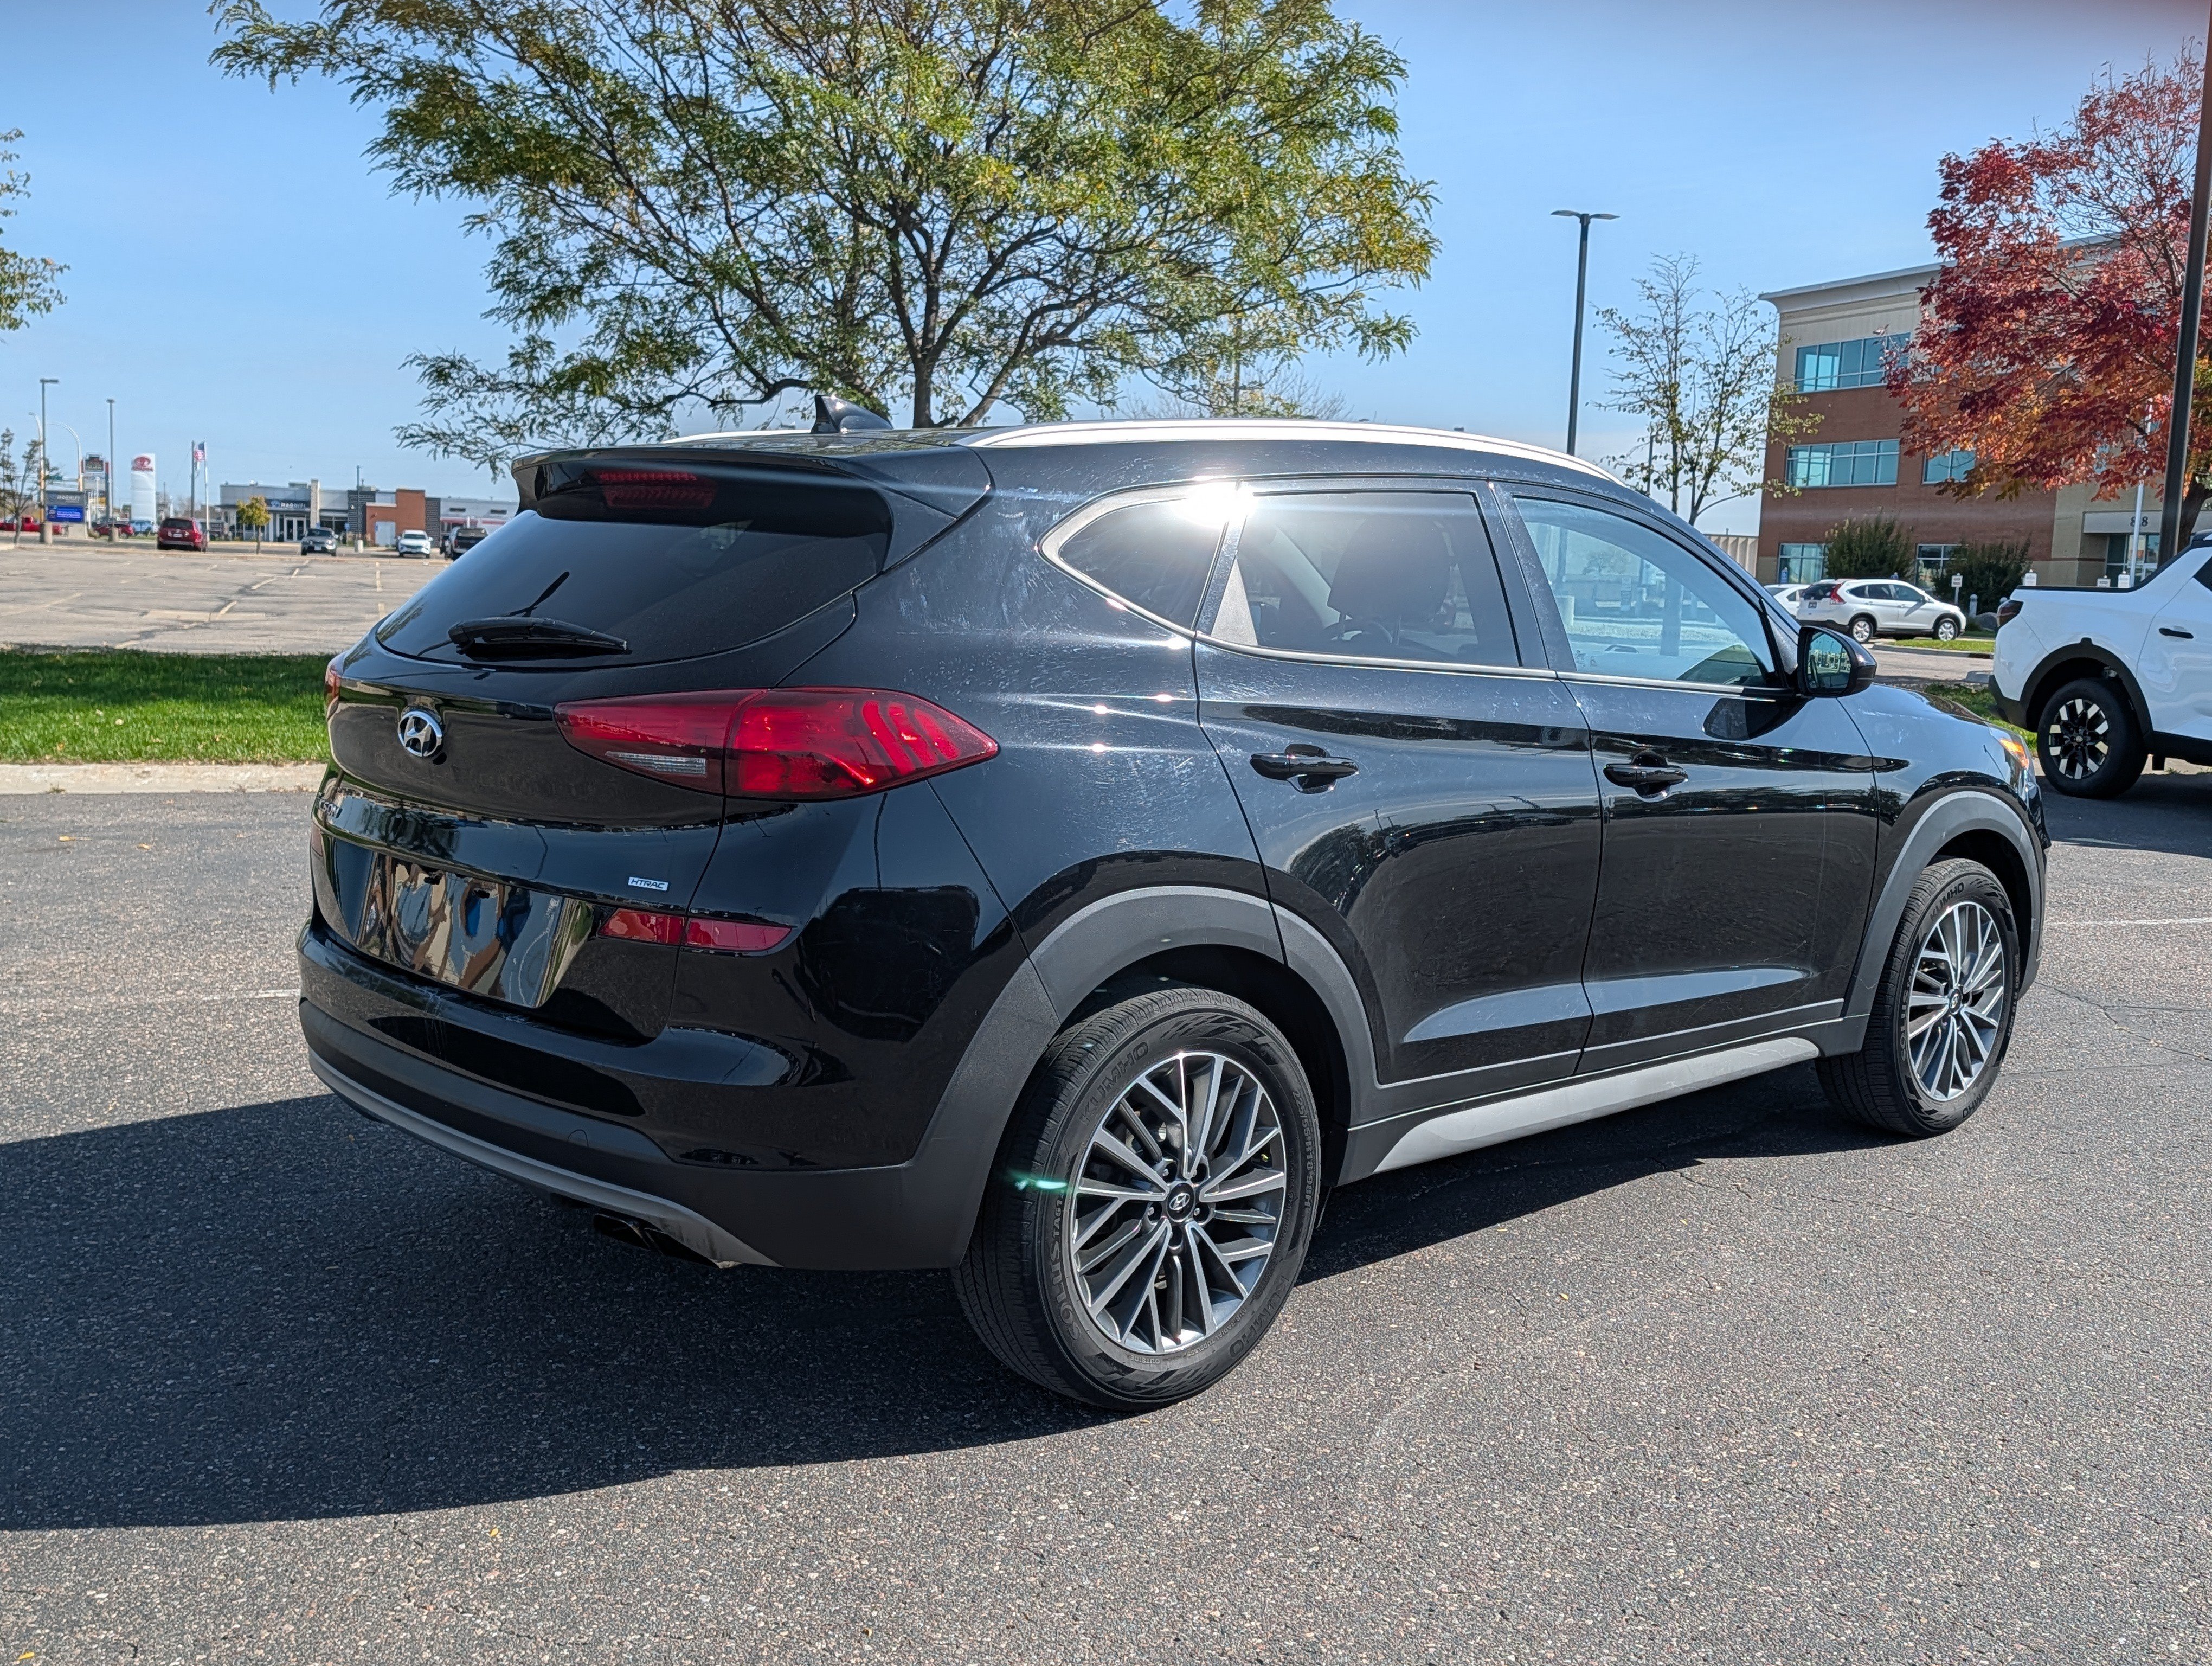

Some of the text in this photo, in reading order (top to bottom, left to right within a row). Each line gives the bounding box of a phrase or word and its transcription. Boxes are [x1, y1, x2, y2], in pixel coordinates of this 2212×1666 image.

[2130, 516, 2148, 527] 88
[318, 799, 340, 818] CSON
[631, 878, 665, 889] HTRAC
[1930, 882, 1965, 921] KUMHO
[1079, 1042, 1149, 1124] KUMHO
[1050, 1241, 1081, 1340] SOLUS
[1229, 1276, 1290, 1359] KUMHO
[1130, 1355, 1160, 1365] OUTSIDE
